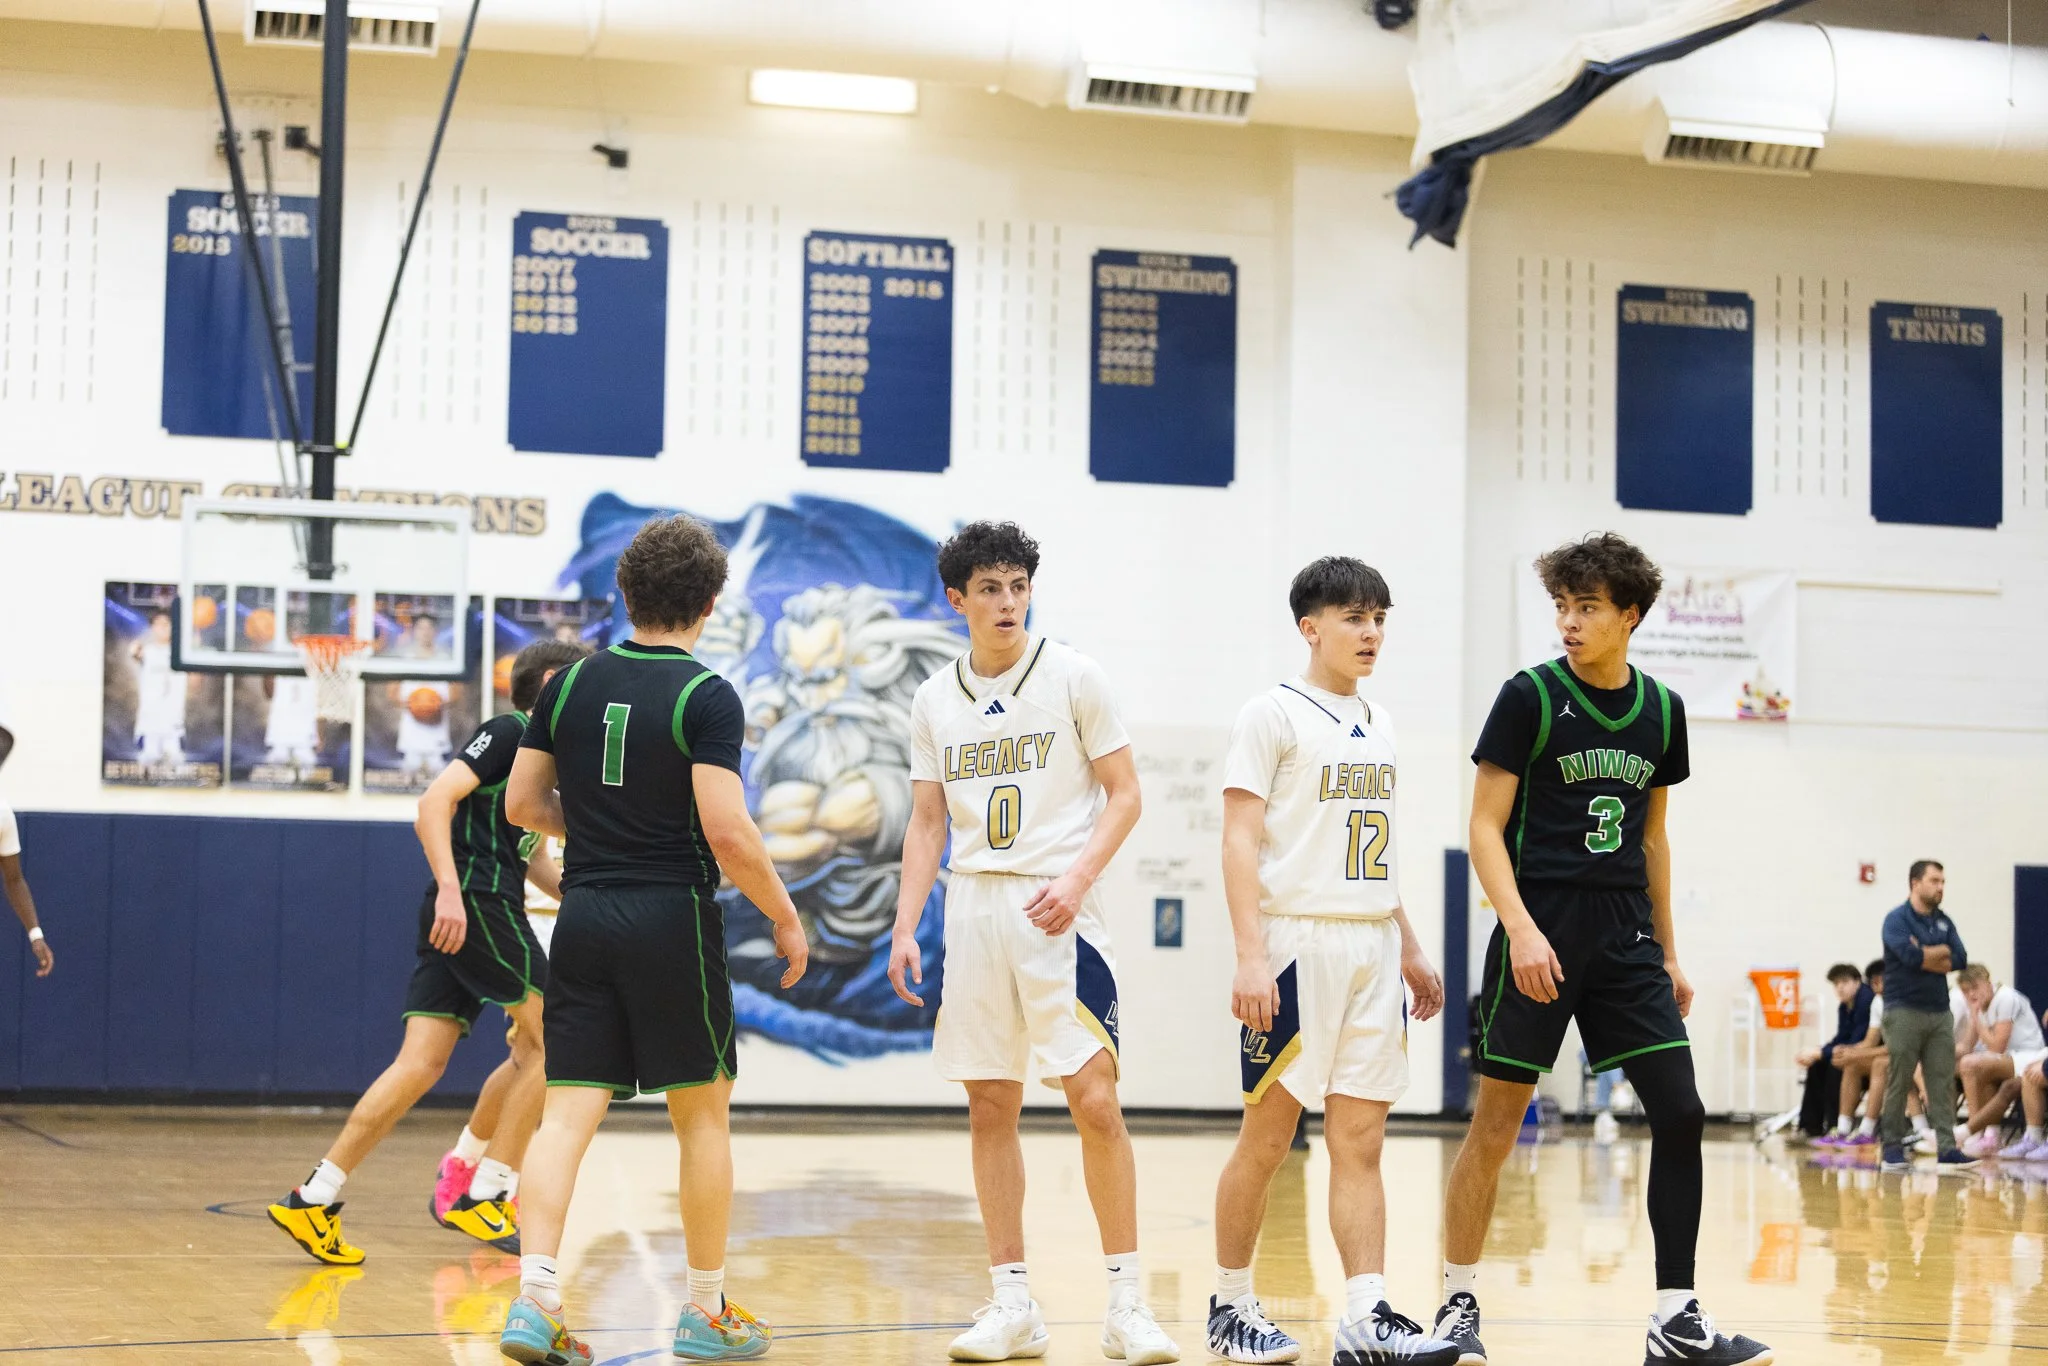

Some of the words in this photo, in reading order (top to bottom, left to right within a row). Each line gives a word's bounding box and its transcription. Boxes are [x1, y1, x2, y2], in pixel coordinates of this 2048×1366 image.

[187, 206, 311, 239] SOCCER
[531, 227, 651, 260] SOCCER
[808, 238, 950, 272] SOFTBALL
[1097, 264, 1231, 296] SWIMMING
[1622, 300, 1748, 331] SWIMMING
[1887, 317, 1987, 347] TENNIS
[602, 702, 632, 787] 1
[945, 732, 1056, 782] LEGACY
[1557, 749, 1656, 790] NIWOT
[987, 784, 1021, 850] 0
[1584, 796, 1625, 853] 3
[1346, 810, 1389, 880] 12
